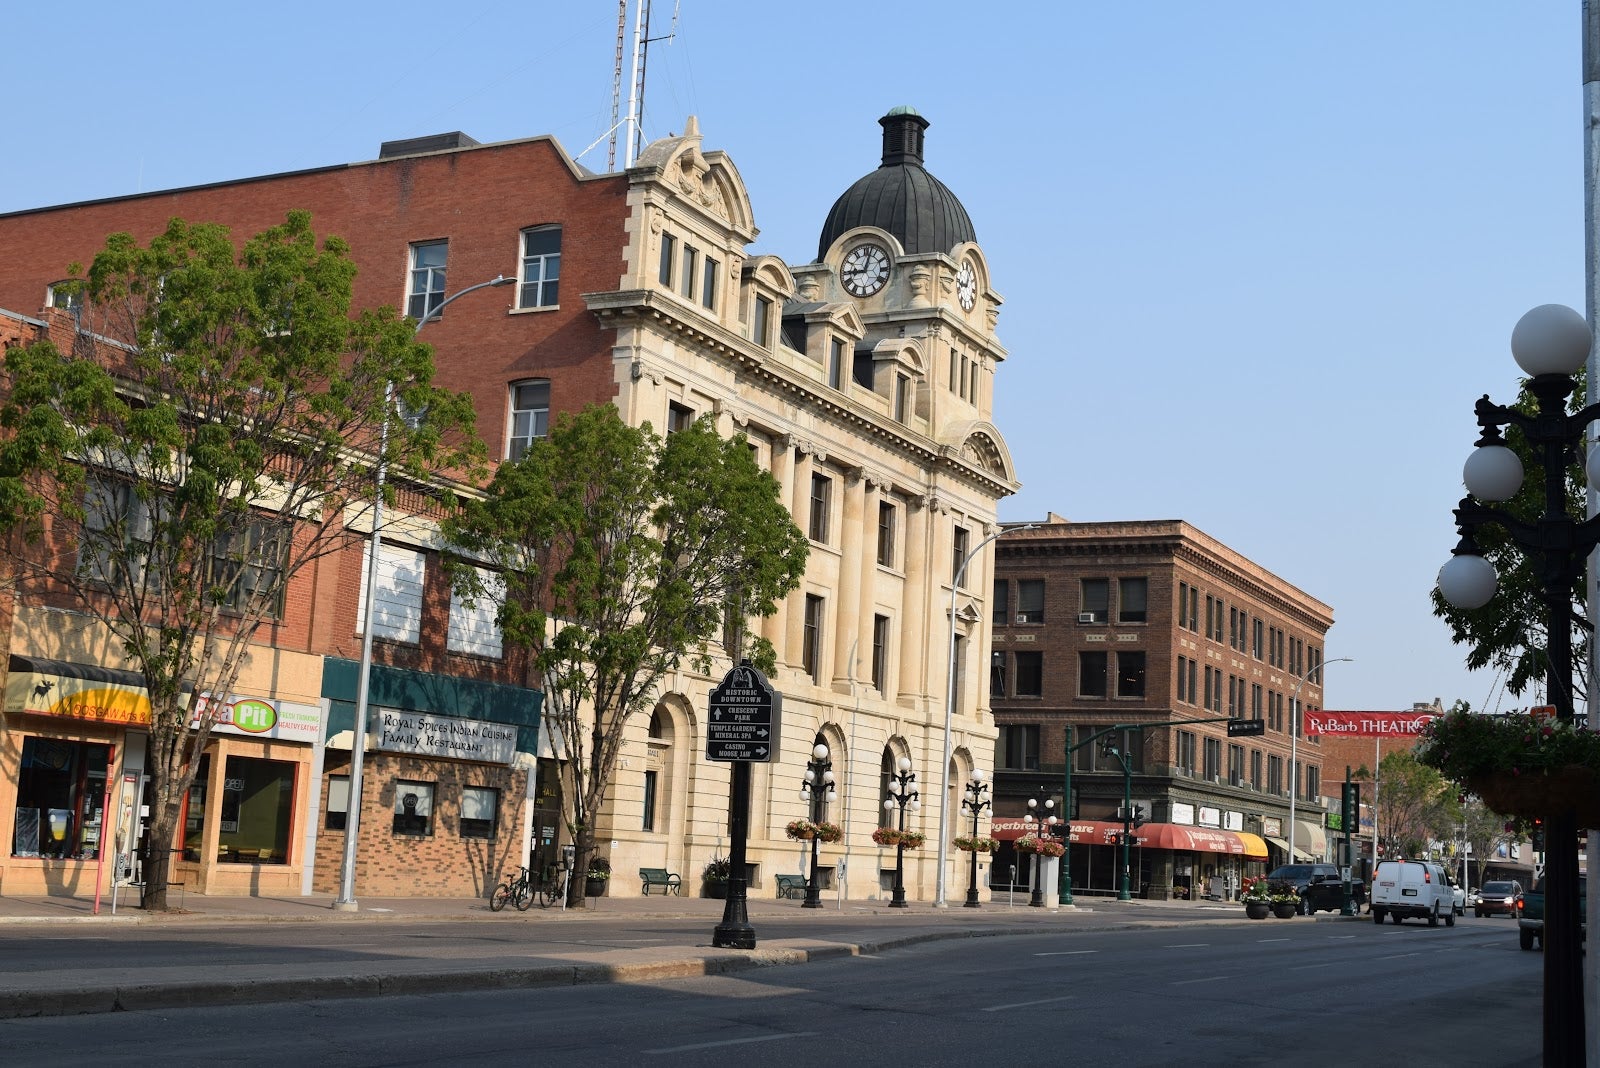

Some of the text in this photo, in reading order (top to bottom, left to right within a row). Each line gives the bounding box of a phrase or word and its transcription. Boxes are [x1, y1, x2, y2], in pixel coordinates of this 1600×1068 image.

[120, 711, 138, 721] Arts
[240, 704, 268, 727] Pit
[1311, 719, 1357, 734] RuBarb
